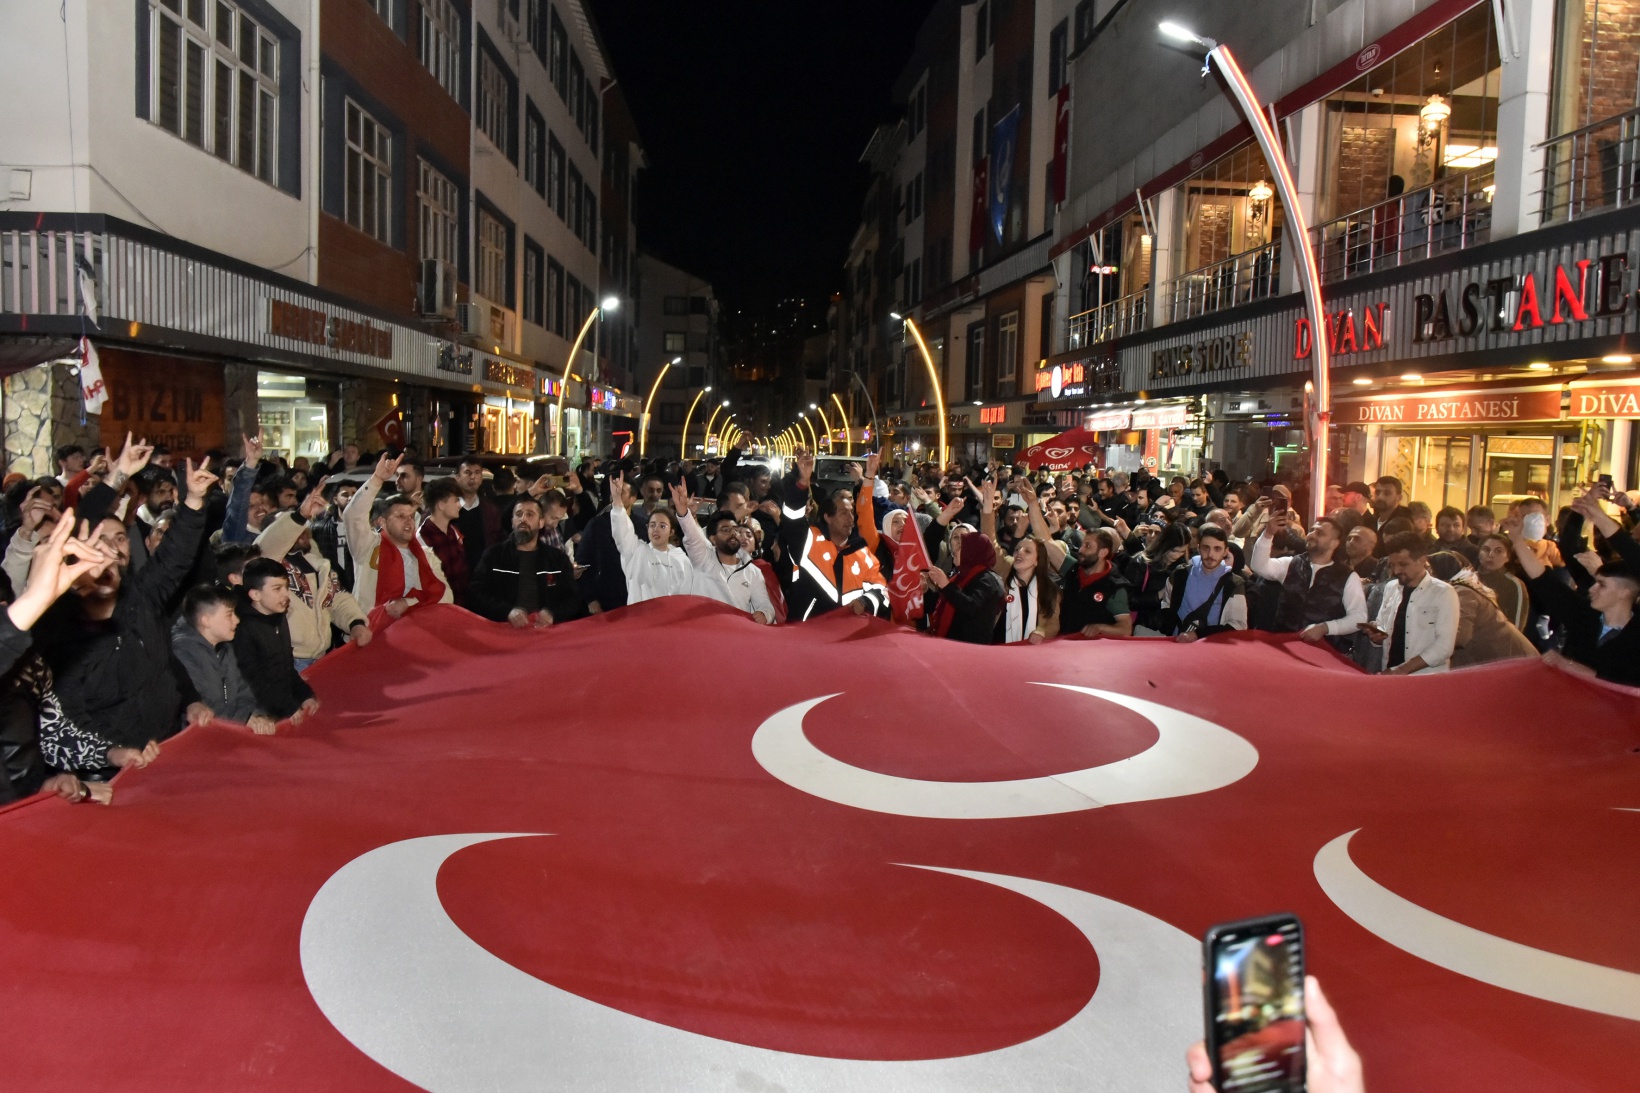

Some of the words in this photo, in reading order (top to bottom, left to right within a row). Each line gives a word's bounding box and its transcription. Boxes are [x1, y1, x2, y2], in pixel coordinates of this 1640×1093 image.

[1294, 301, 1387, 360] DVAN
[1413, 252, 1640, 343] PASTANE
[1148, 345, 1194, 380] JEANS
[1194, 333, 1247, 373] STORE
[1359, 402, 1405, 421] DİVAN
[1417, 396, 1519, 421] PASTANESİ
[1579, 390, 1640, 415] DİVA
